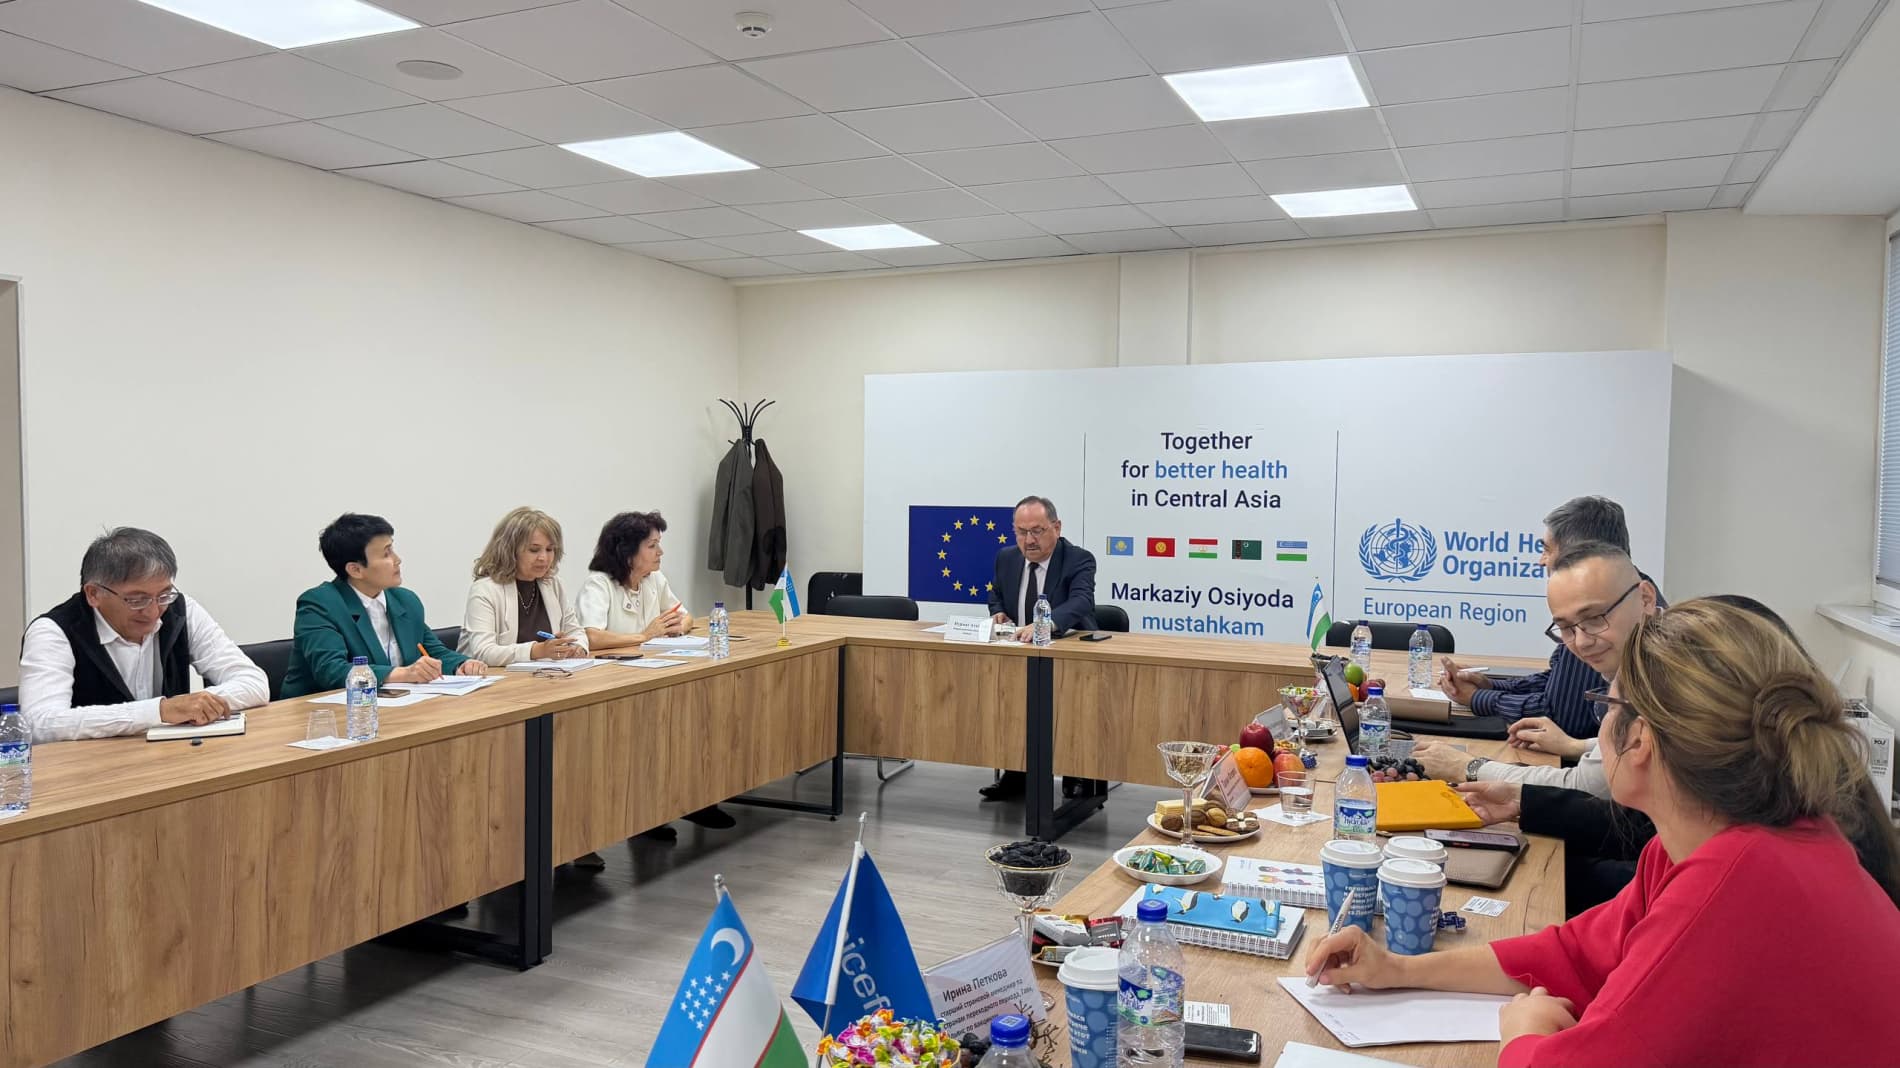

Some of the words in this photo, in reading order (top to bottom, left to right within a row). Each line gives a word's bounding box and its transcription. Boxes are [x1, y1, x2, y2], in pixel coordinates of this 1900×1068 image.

[1161, 431, 1253, 455] Together
[1120, 459, 1150, 479] for
[1155, 459, 1216, 479] better
[1221, 459, 1288, 480] health
[1131, 488, 1148, 507] in
[1154, 489, 1228, 508] Central
[1234, 489, 1281, 509] Asia
[1444, 530, 1509, 553] World
[1443, 555, 1545, 581] Organiza
[1111, 582, 1202, 609] Markaziy
[1208, 586, 1294, 612] Osiyoda
[1363, 597, 1452, 621] European
[1460, 601, 1528, 627] Region
[1142, 614, 1264, 637] mustahkam
[842, 932, 892, 1010] icef
[942, 983, 973, 1003] Ирина
[972, 968, 1009, 991] Петкова
[940, 1002, 964, 1019] старший
[943, 1015, 966, 1031] странам
[965, 1001, 999, 1021] переходного
